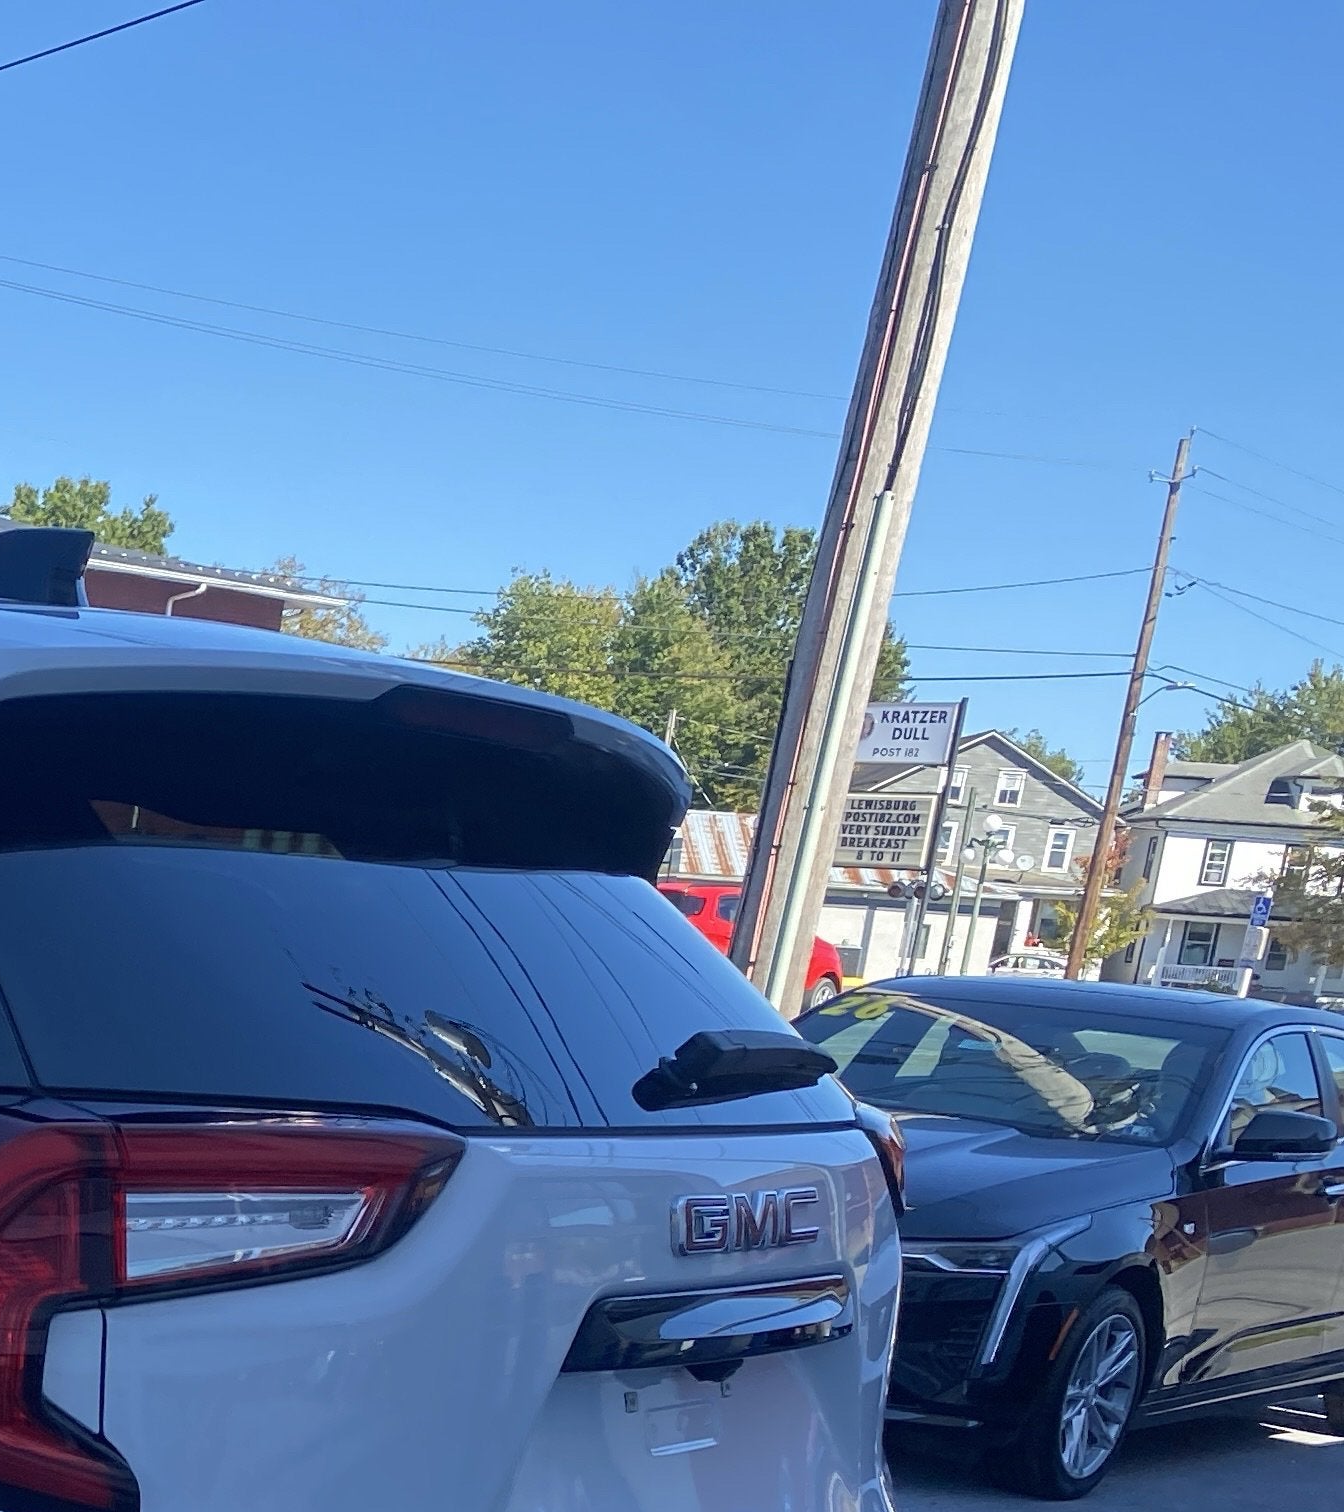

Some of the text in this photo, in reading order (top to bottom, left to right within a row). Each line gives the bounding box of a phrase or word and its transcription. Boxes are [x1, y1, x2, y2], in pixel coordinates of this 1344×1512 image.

[880, 710, 948, 724] KRATZER
[892, 727, 930, 741] DULL
[872, 747, 920, 757] POST 182
[850, 800, 917, 811] LEWISBURG
[844, 811, 921, 824] POST182.COM
[873, 825, 921, 837] SUNDAY
[840, 837, 908, 849] BREAKFAST
[856, 850, 864, 860] 8
[870, 851, 884, 861] TO
[819, 996, 900, 1019] 26
[671, 1186, 819, 1256] GMC
